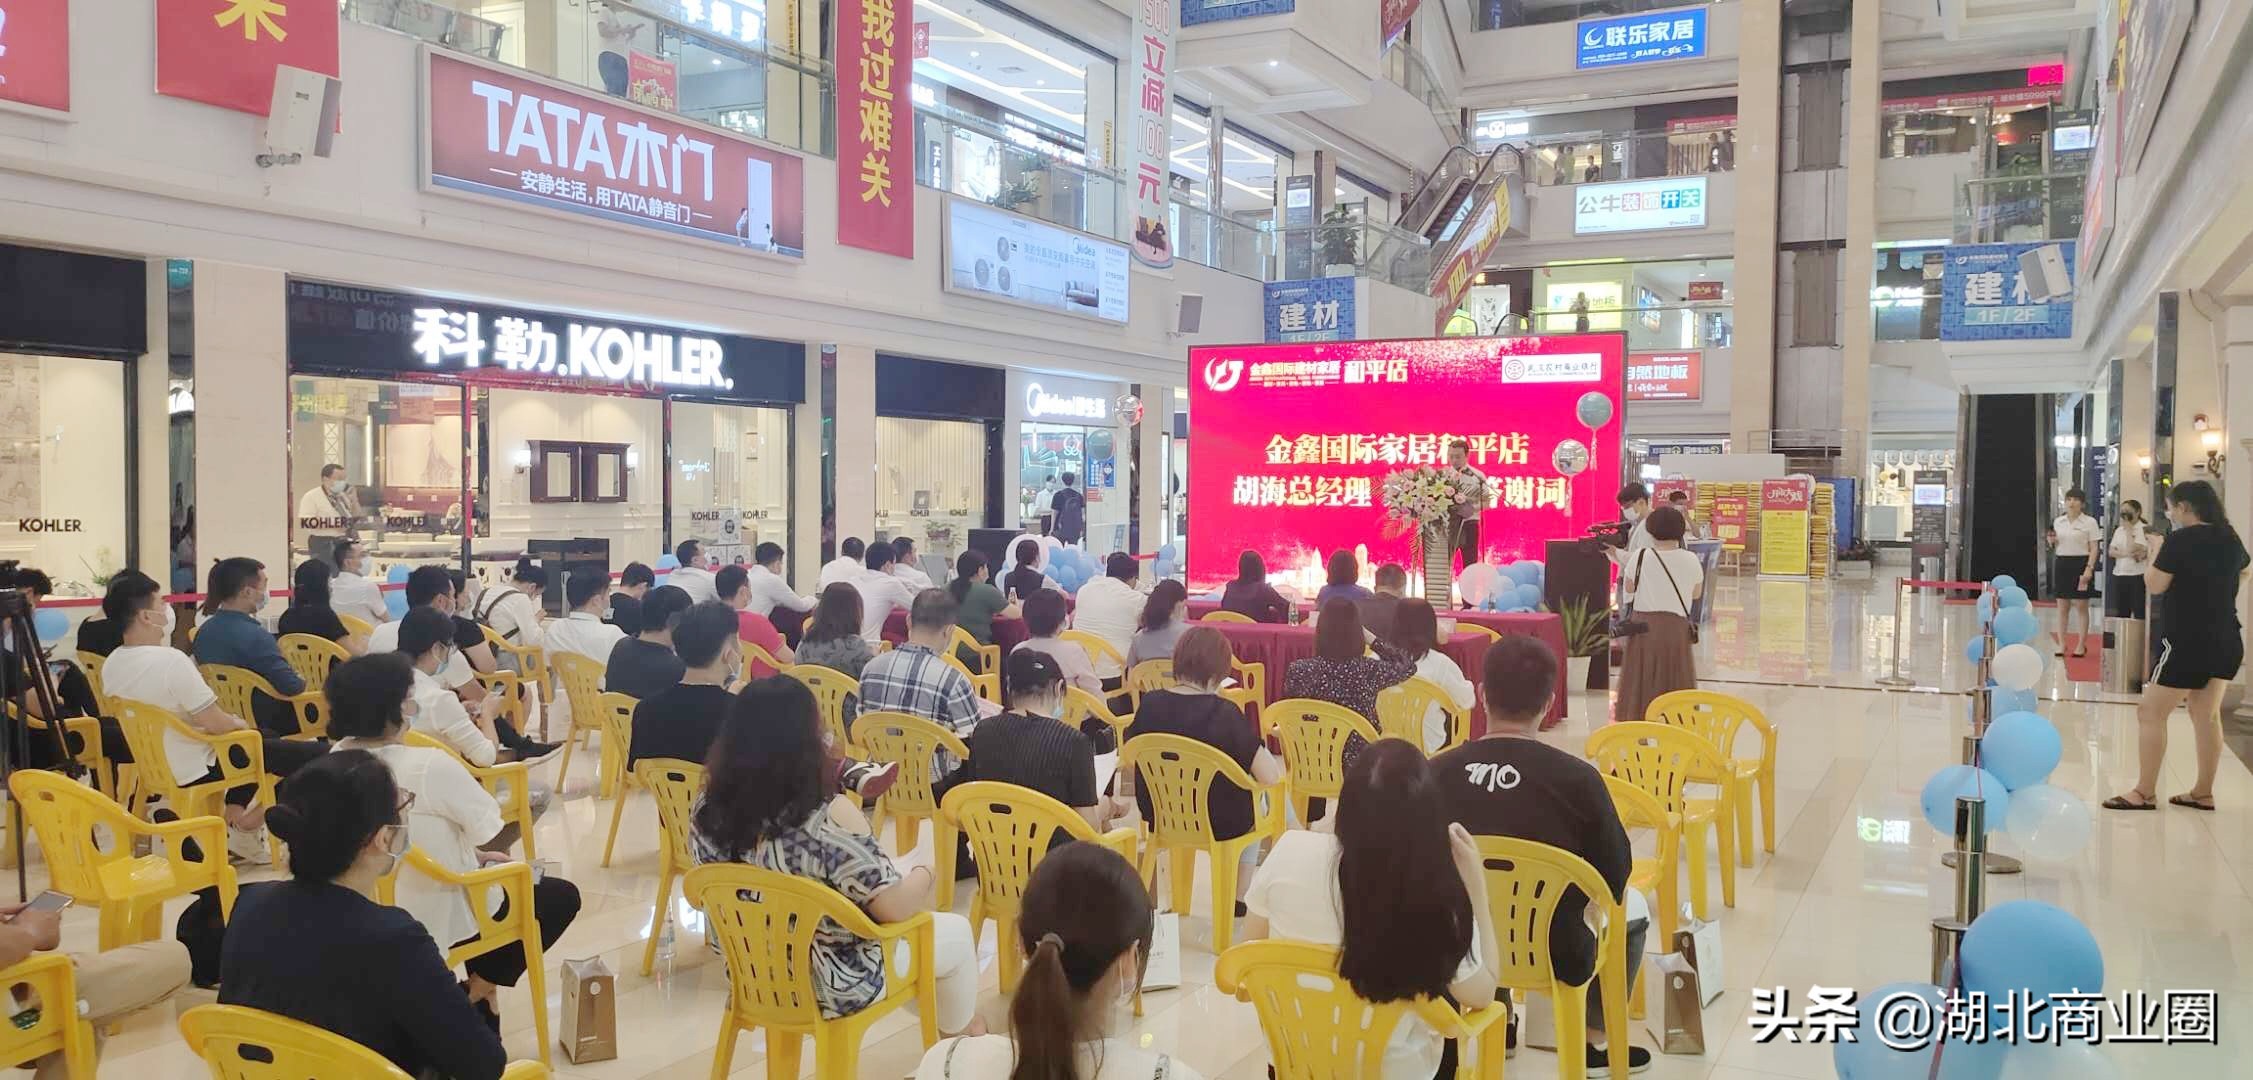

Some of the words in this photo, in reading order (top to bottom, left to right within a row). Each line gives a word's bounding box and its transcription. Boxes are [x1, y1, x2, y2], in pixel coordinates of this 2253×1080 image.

[1605, 19, 1694, 47] 联乐家居
[859, 0, 896, 208] 我过难关
[472, 80, 715, 202] TATA木门
[1578, 188, 1700, 214] 公牛装饰开关
[1279, 300, 1340, 332] 建材
[1344, 359, 1408, 383] 和平店
[1233, 475, 1373, 508] 胡海总经理
[18, 518, 82, 532] KOHLER
[691, 511, 720, 521] KOHLER
[742, 510, 768, 520] KOHLER
